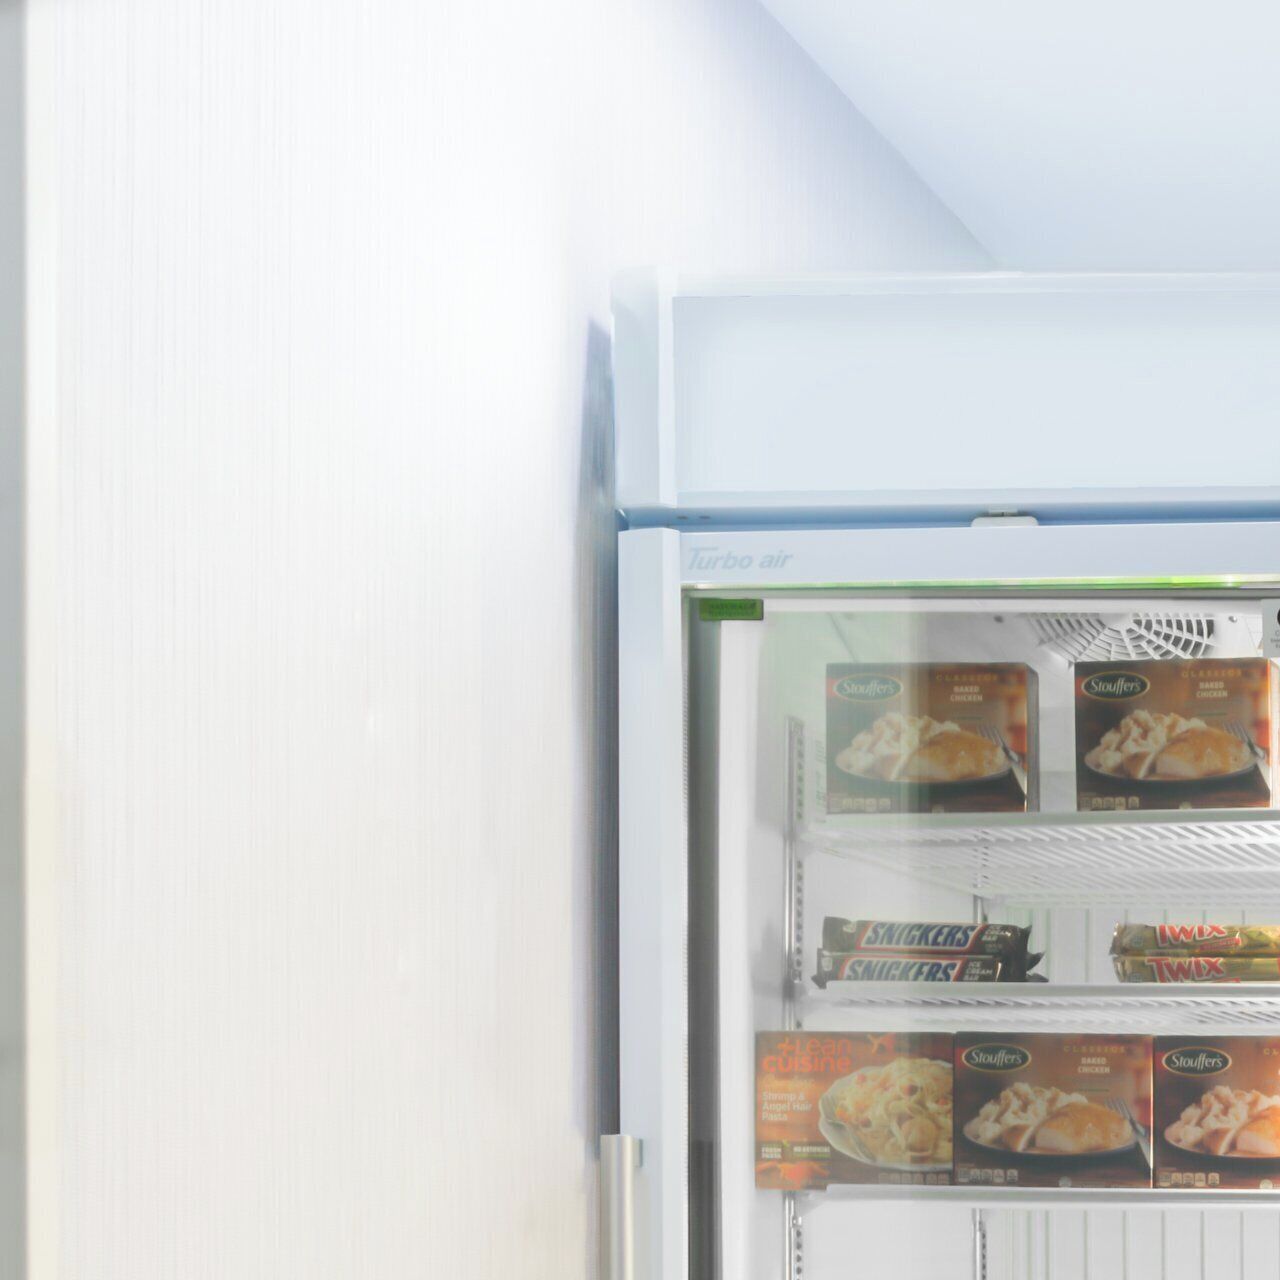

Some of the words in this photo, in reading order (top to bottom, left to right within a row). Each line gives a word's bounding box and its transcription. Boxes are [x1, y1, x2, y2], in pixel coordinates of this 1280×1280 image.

[688, 547, 753, 571] Turbo
[759, 550, 794, 569] air
[864, 921, 980, 948] SNICKERS
